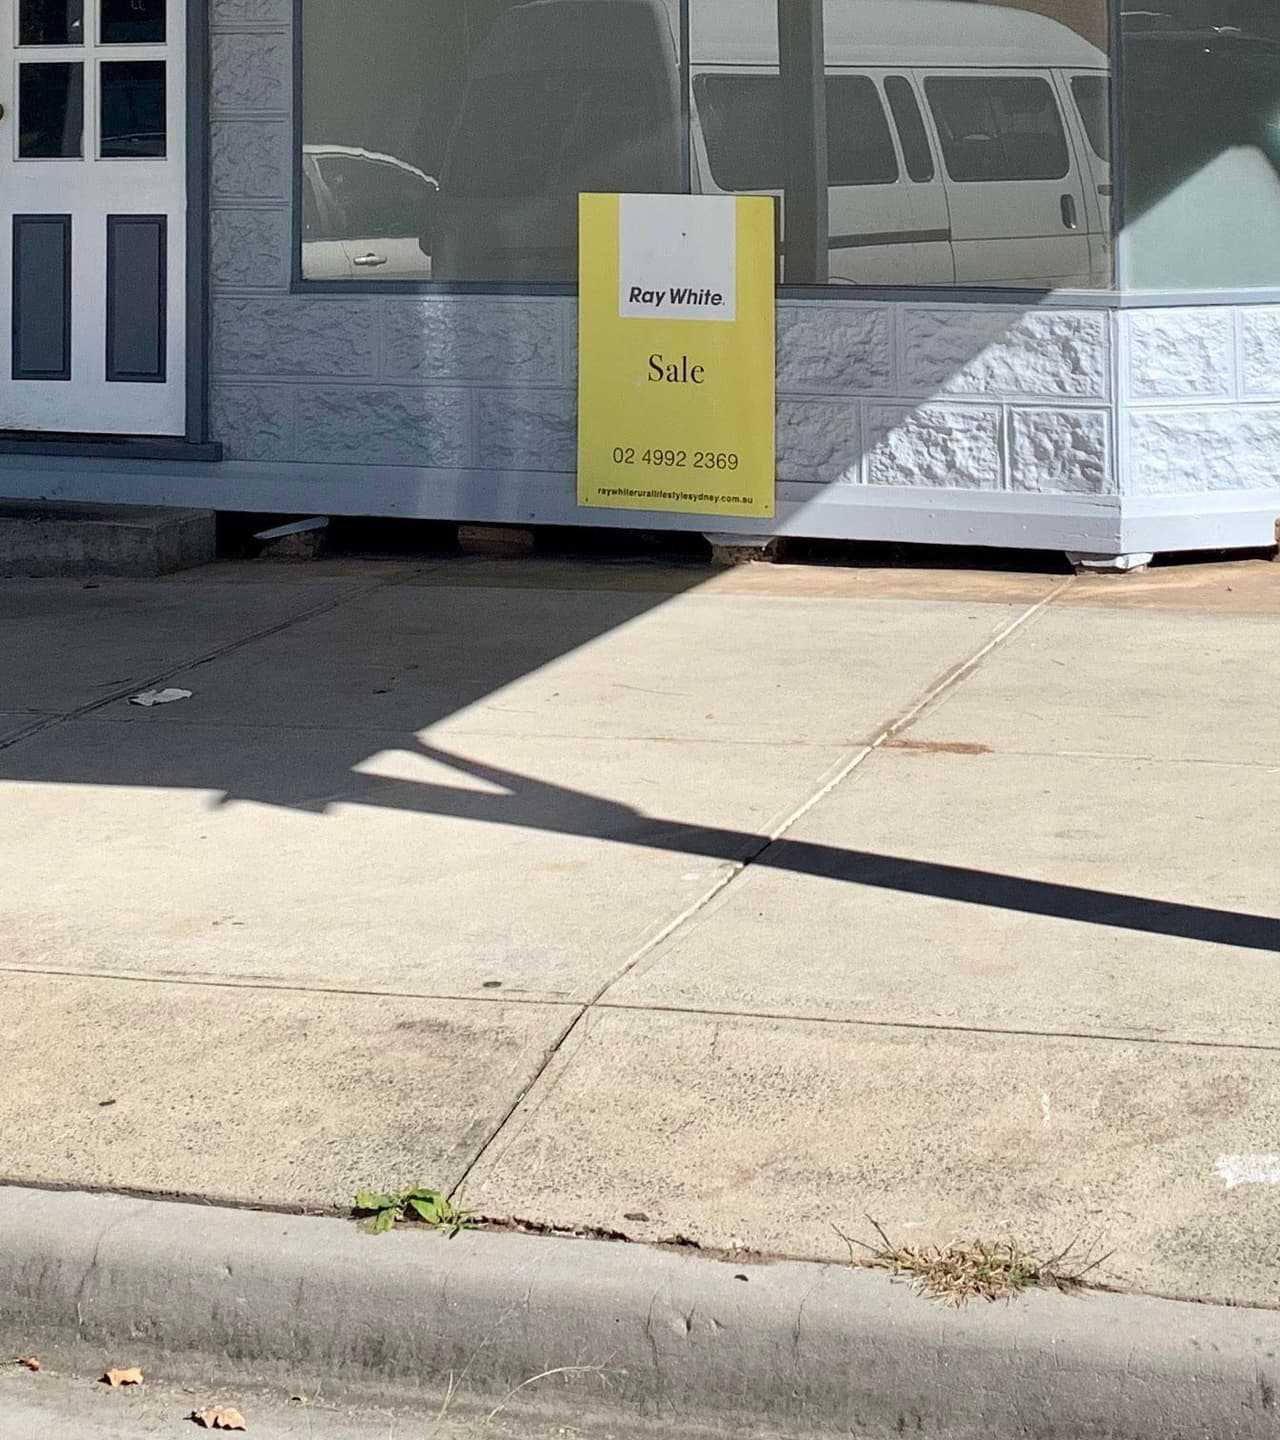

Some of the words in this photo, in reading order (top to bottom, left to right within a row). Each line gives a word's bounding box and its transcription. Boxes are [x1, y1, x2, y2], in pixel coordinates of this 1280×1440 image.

[629, 286, 666, 307] Ray
[647, 353, 705, 384] Sale
[613, 447, 635, 464] 02
[641, 449, 687, 467] 4992
[693, 451, 738, 470] 2369
